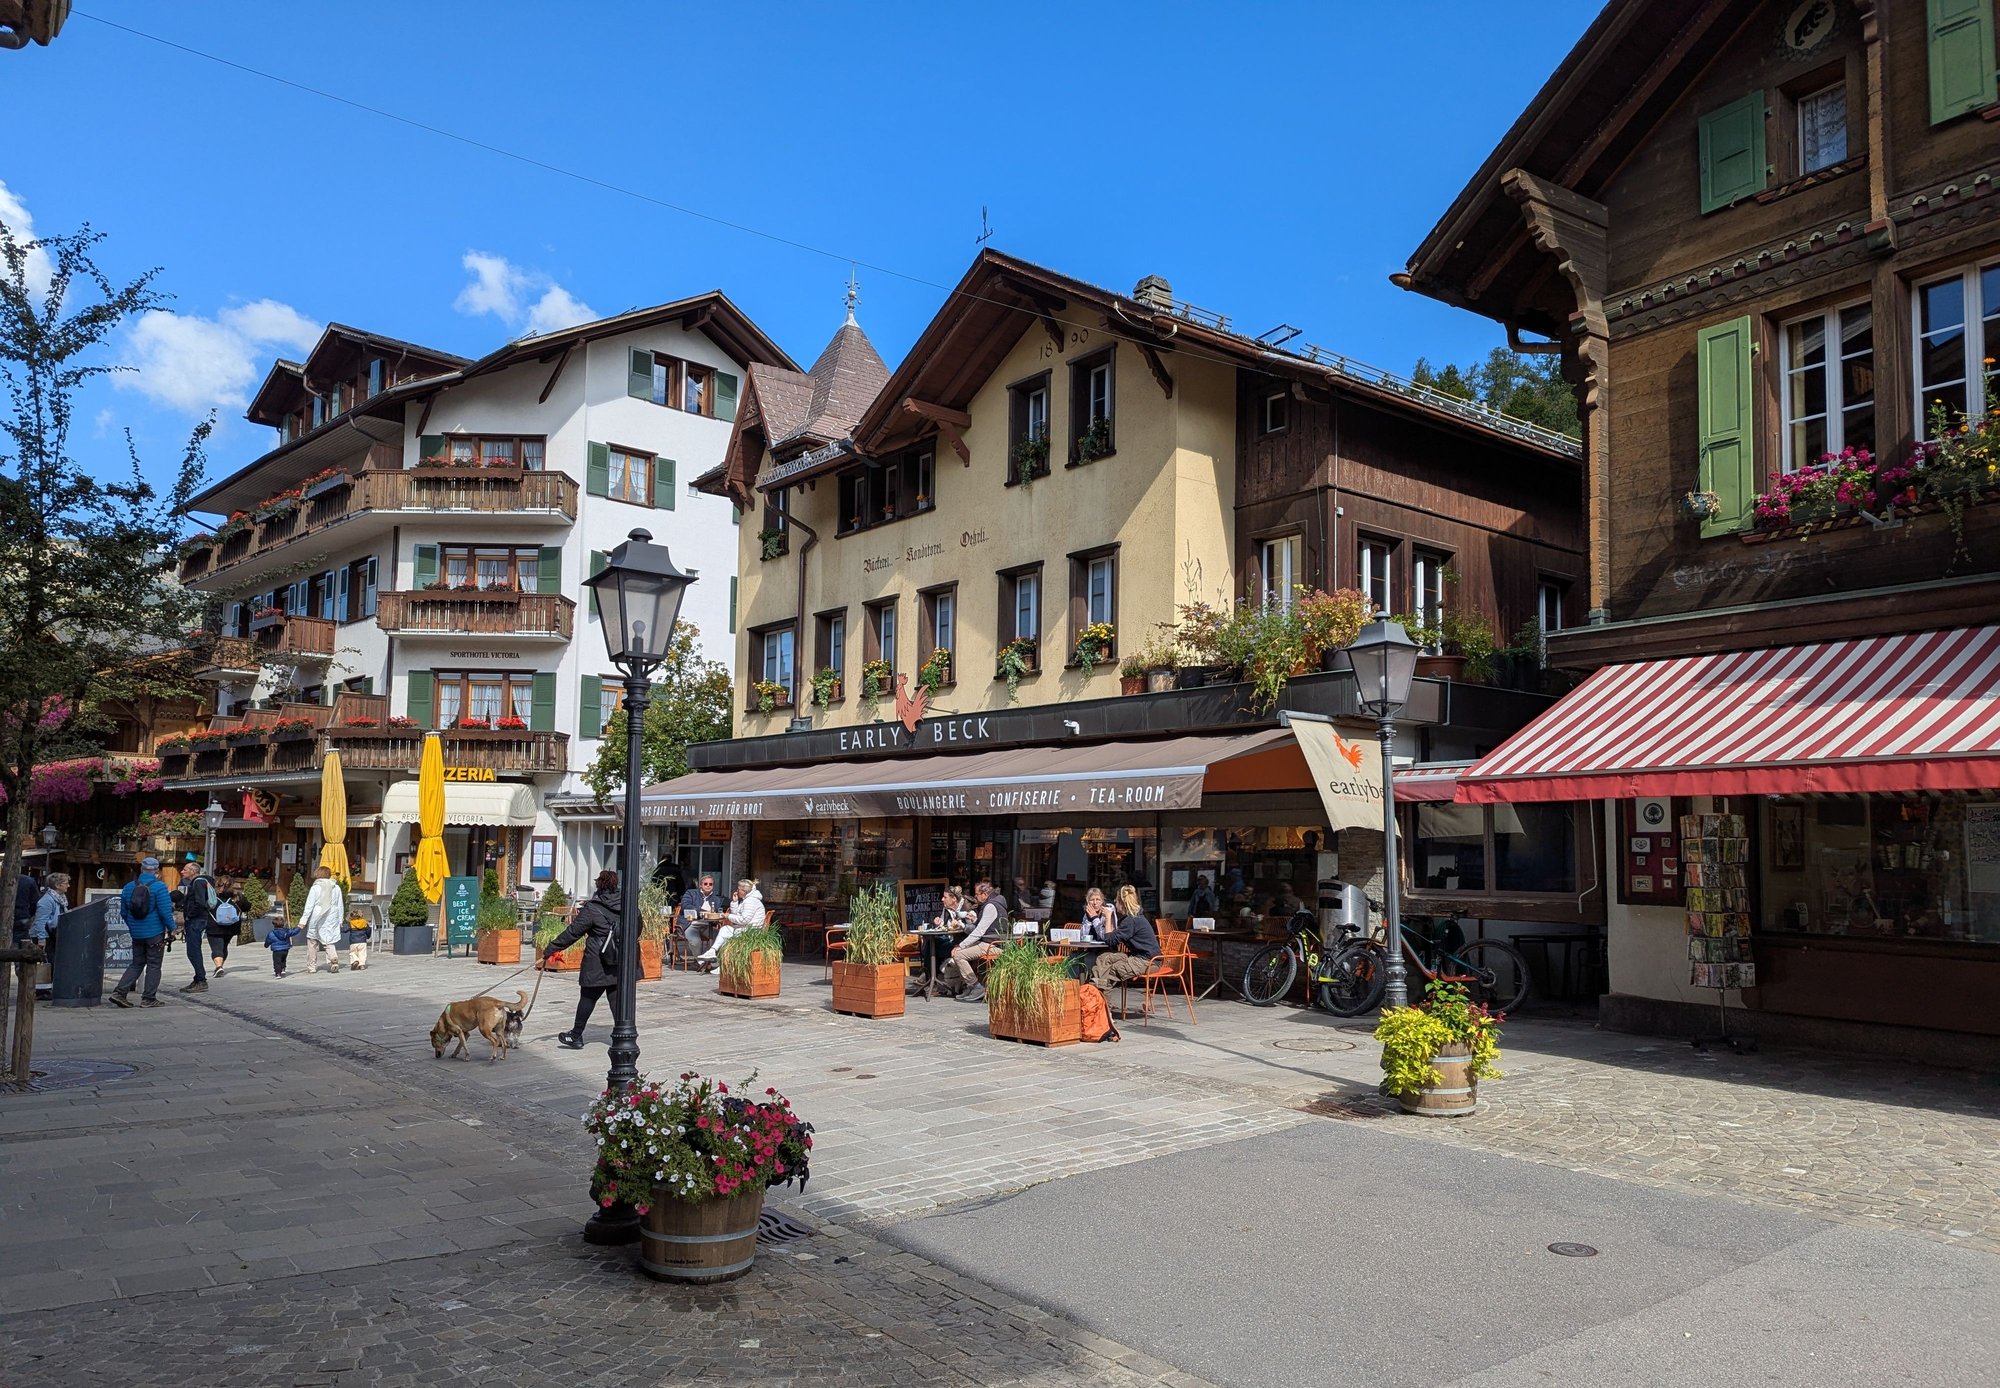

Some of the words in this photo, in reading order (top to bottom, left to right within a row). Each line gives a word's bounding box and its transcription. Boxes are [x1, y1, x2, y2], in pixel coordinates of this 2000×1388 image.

[450, 651, 490, 659] SPORTHOTEL
[840, 726, 901, 751] EARLY
[933, 717, 990, 742] BECK
[896, 794, 966, 810] BOULANGERIE
[990, 790, 1061, 808] CONFISERIE
[1090, 785, 1165, 803] TEA-ROOM
[653, 806, 667, 817] FAIT
[669, 805, 678, 817] LE
[680, 805, 696, 816] PAIN
[708, 804, 724, 816] ZEIT
[726, 801, 740, 815] FÜR
[743, 803, 763, 815] BROT
[815, 799, 849, 812] earlybeck
[448, 814, 484, 823] VICTORIA
[452, 900, 468, 908] BEST
[456, 914, 476, 922] CREAM
